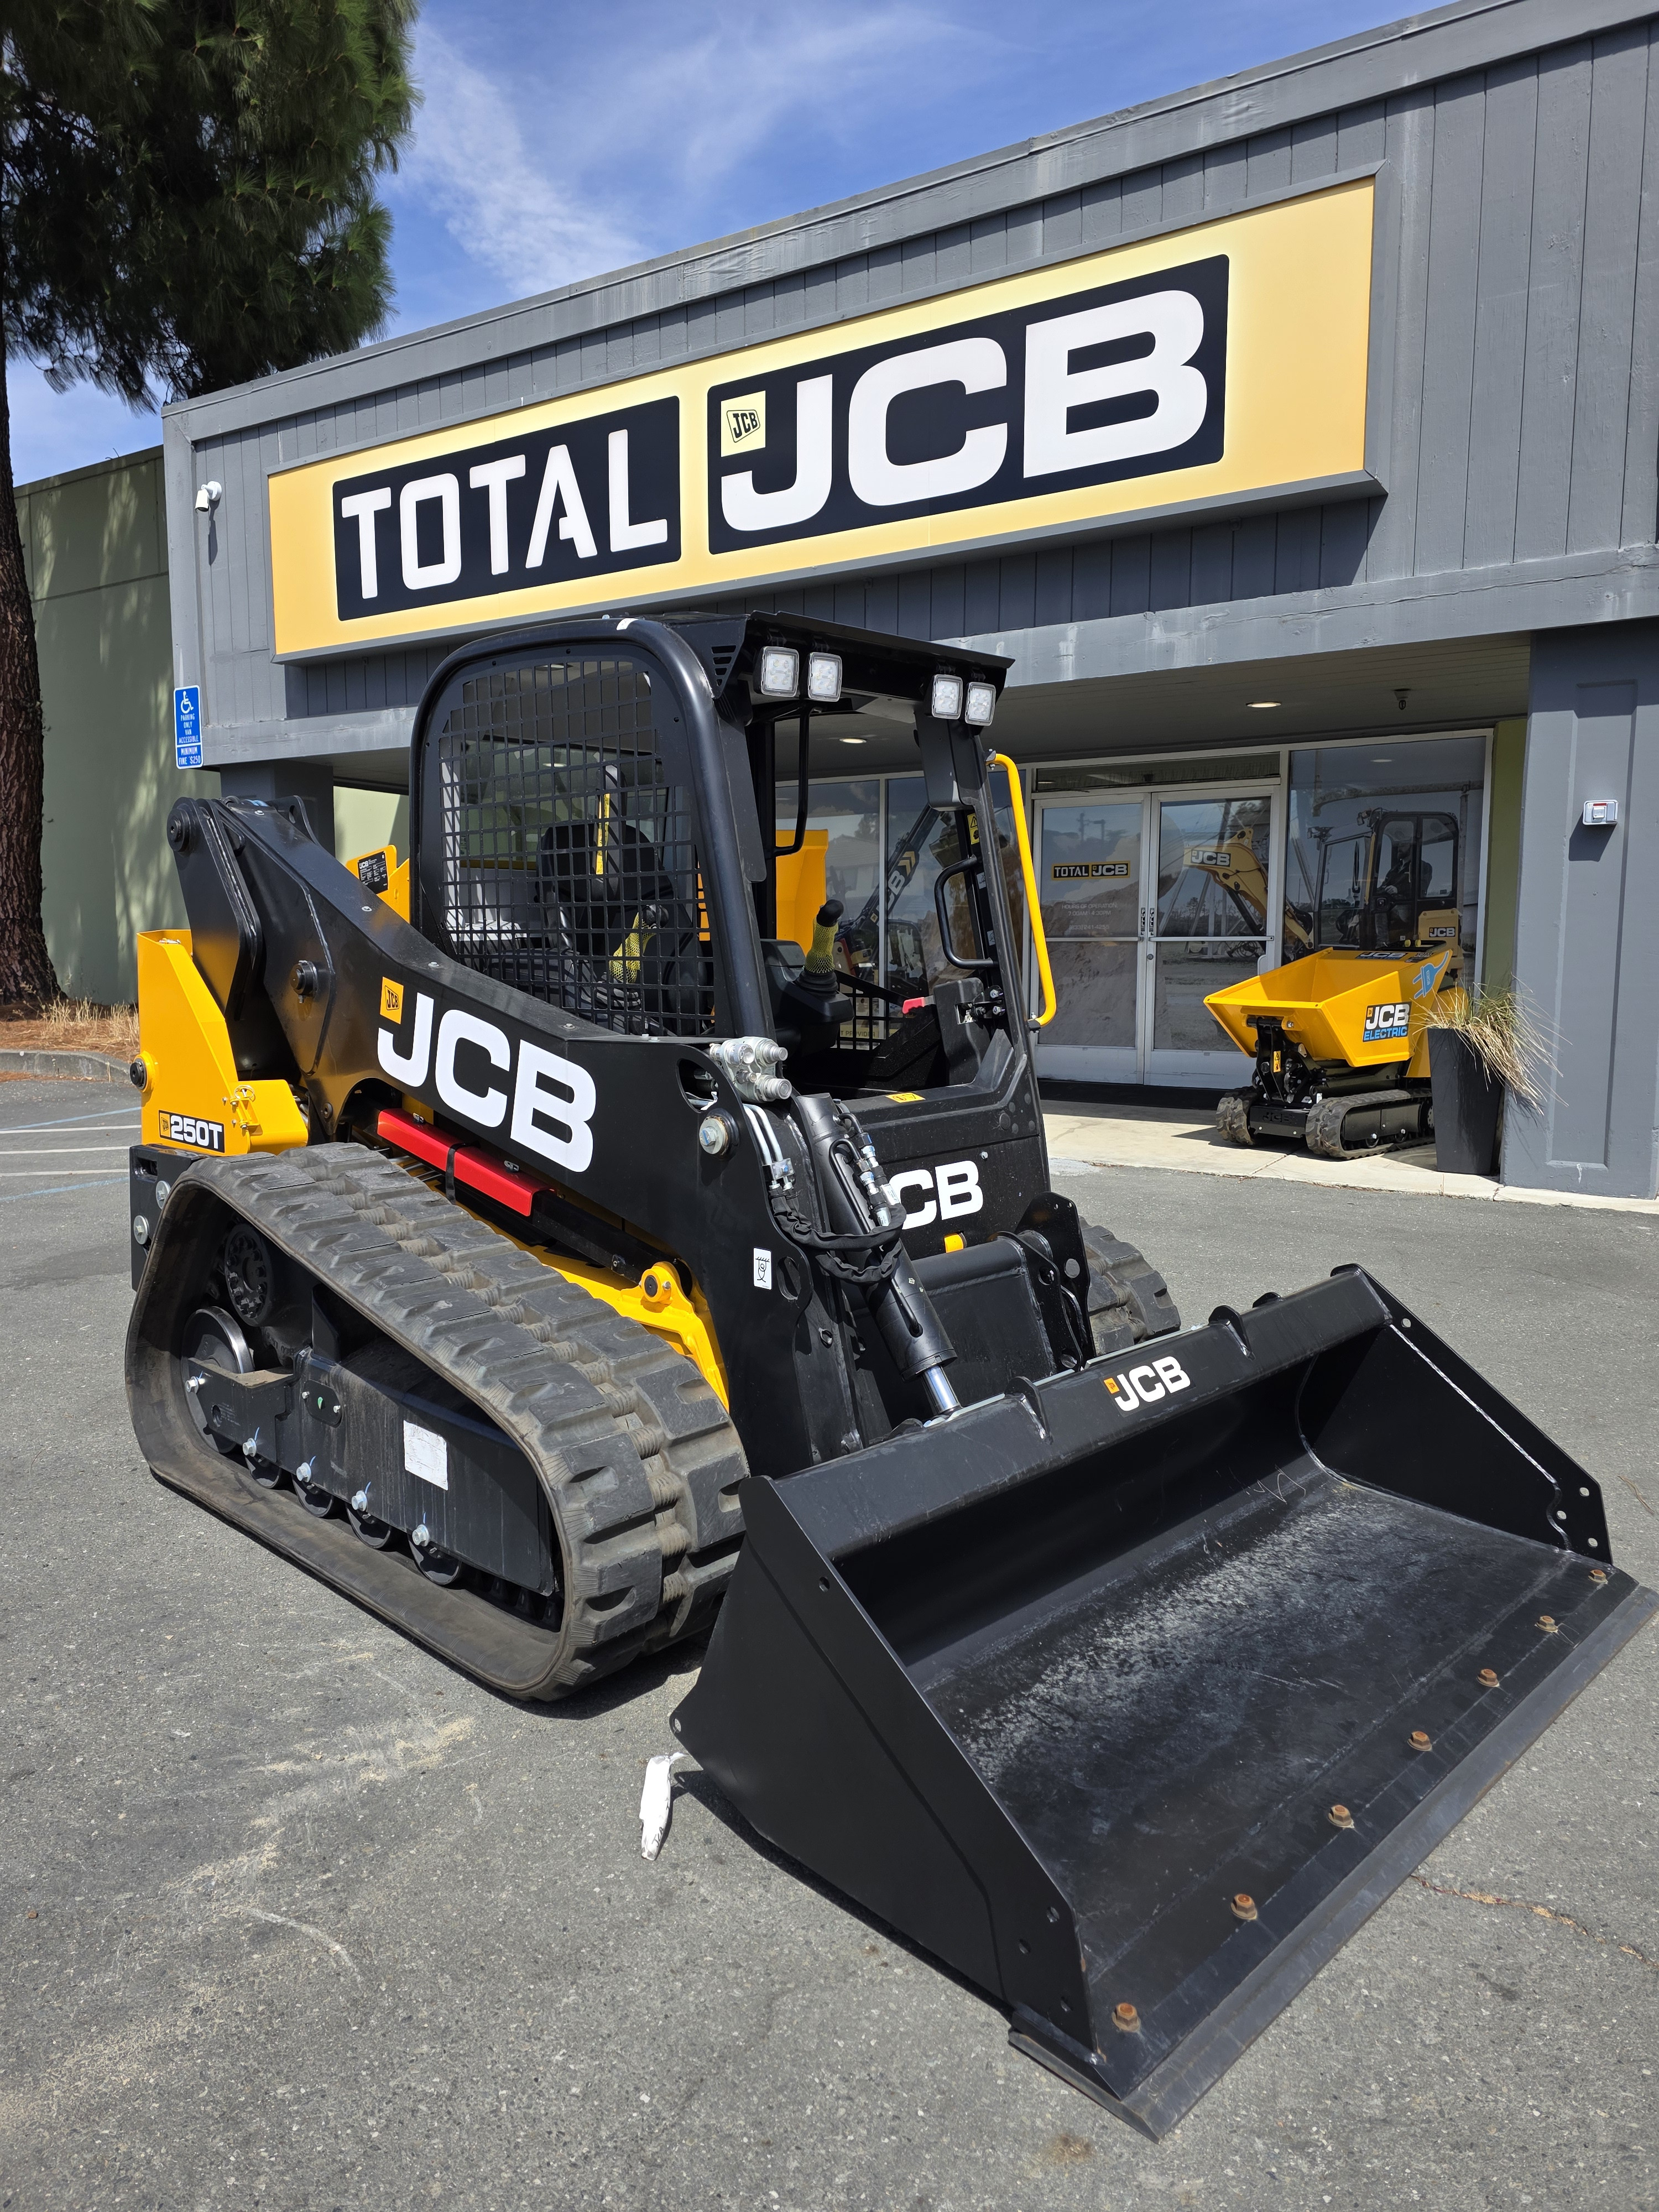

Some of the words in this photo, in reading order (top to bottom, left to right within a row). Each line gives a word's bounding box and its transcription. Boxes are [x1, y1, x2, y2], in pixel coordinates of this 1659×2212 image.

[733, 412, 758, 438] JCB
[342, 429, 667, 599] TOTAL
[721, 290, 1207, 531] JCB
[179, 735, 199, 744] ACCESSIBLE
[181, 747, 197, 755] MINIMUM
[190, 755, 201, 764] $250
[359, 860, 369, 869] JCB
[1192, 851, 1230, 865] JCB
[1055, 866, 1088, 877] TOTAL
[1092, 864, 1127, 876] JCB
[1430, 927, 1455, 937] JCB
[387, 989, 399, 1008] JCB
[1365, 1004, 1410, 1030] JCB
[1364, 1026, 1407, 1041] ELECTRIC
[377, 993, 596, 1172] JCB
[171, 1115, 222, 1149] 250T
[889, 1160, 983, 1229] CB
[1114, 1356, 1191, 1411] JCB
